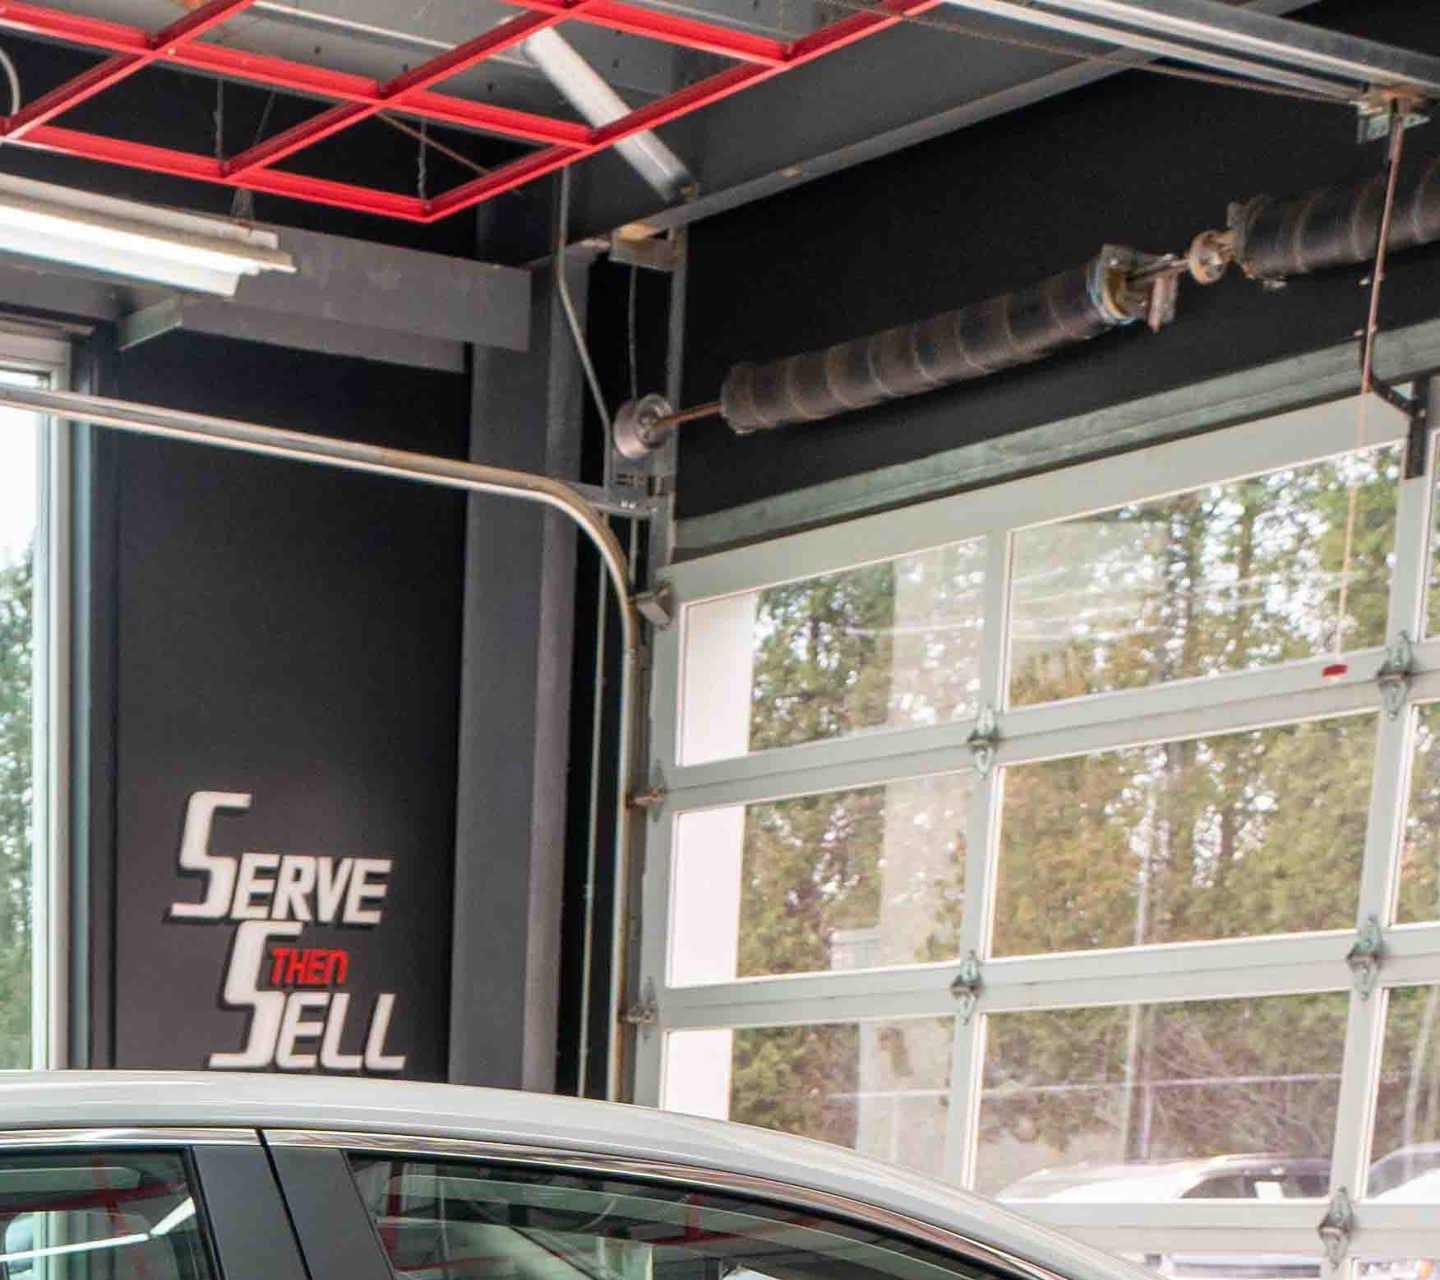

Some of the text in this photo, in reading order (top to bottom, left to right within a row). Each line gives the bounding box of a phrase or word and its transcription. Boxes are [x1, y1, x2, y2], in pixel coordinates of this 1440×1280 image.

[170, 791, 393, 924] SERVE
[208, 920, 406, 1070] SELL
[270, 947, 349, 984] THEN
